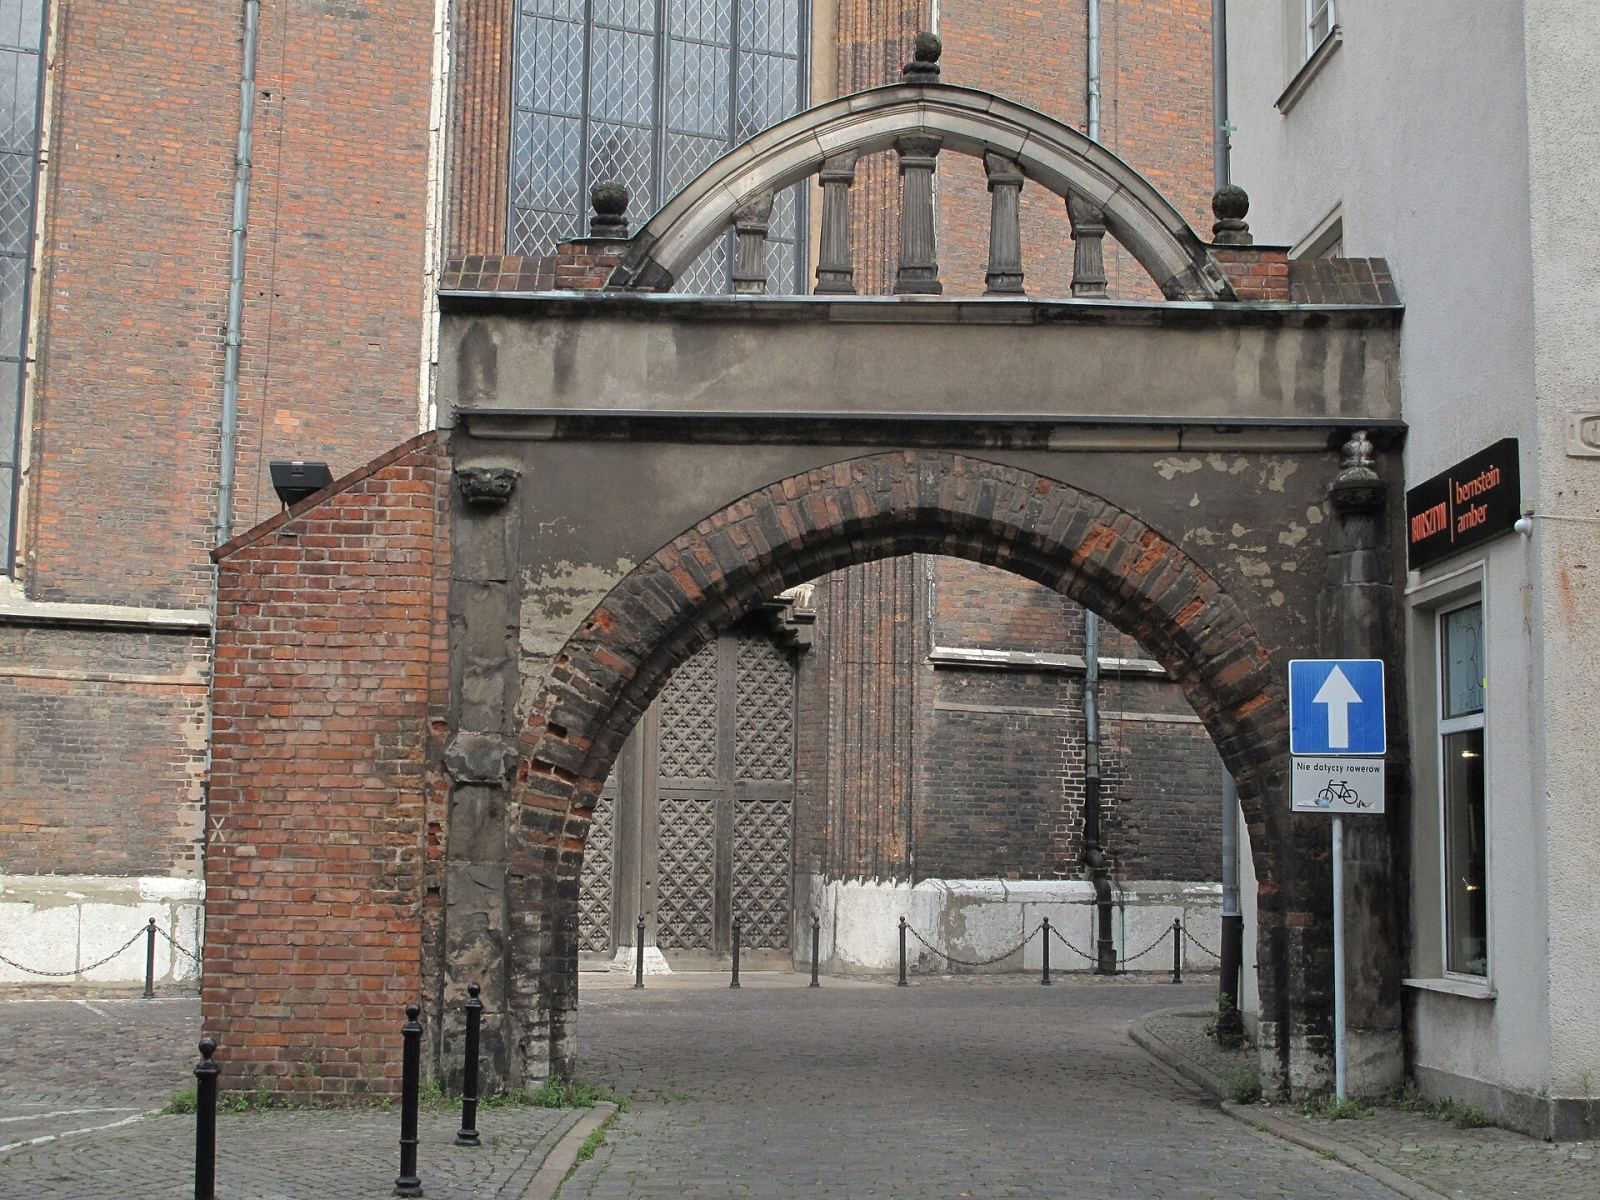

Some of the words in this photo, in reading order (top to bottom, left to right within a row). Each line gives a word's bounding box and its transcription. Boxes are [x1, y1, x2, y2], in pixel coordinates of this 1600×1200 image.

[1456, 465, 1500, 504] bernstein
[1457, 504, 1488, 533] amber
[1296, 762, 1310, 771] Nie
[1313, 762, 1344, 774] dotyczy
